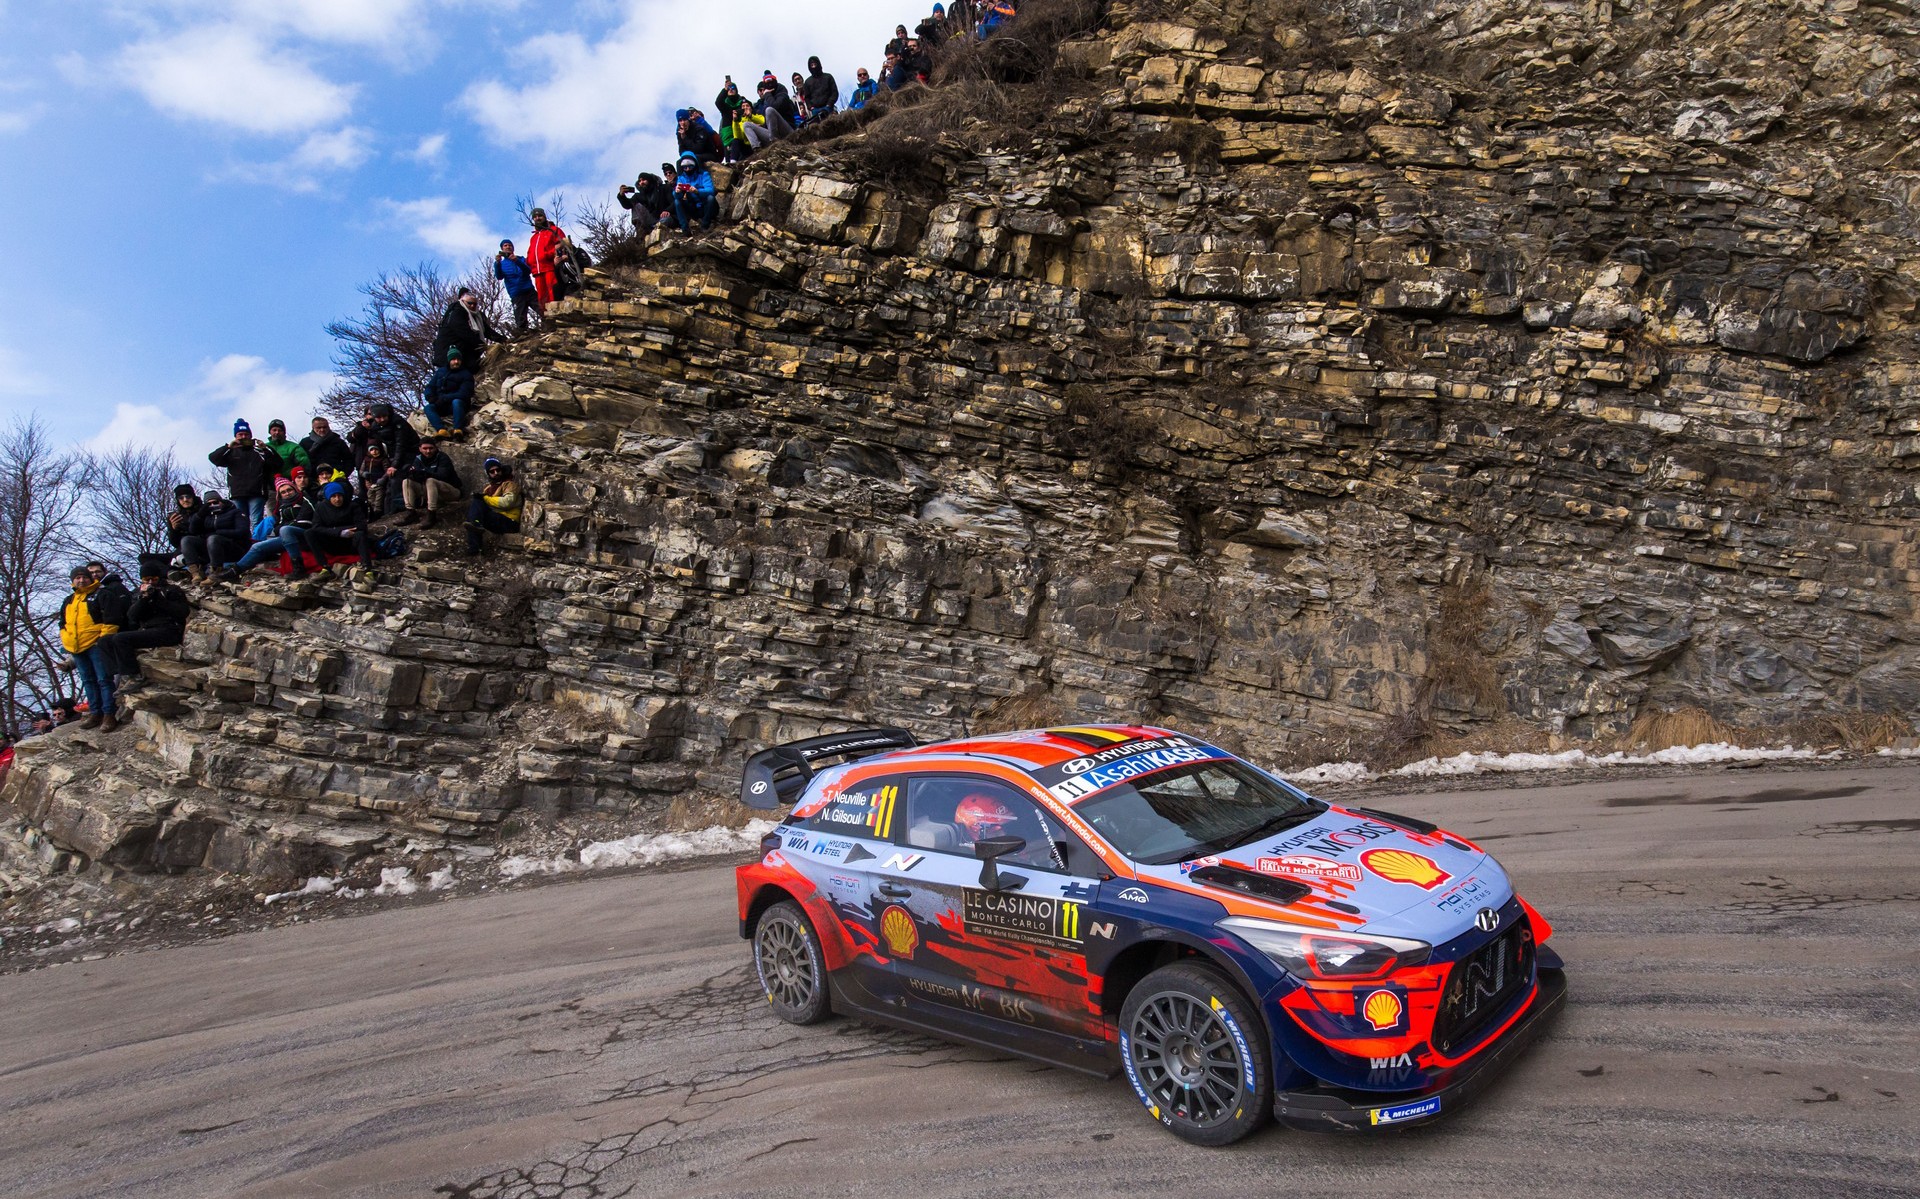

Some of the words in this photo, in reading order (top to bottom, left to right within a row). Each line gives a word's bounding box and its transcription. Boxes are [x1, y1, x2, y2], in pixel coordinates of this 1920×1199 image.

[820, 737, 894, 751] HYUNDAI
[1094, 740, 1164, 761] HYUNDAI
[1089, 747, 1213, 788] AsahiKASEI
[833, 789, 867, 806] Neuville
[1058, 781, 1089, 799] 11
[821, 808, 830, 820] N.
[832, 810, 862, 825] Gilsoul
[874, 785, 899, 838] 11
[1030, 786, 1107, 857] motorsport.hyundai.com
[788, 837, 809, 851] WIA
[828, 840, 853, 849] HYUNDAI
[1267, 827, 1333, 856] HYUNDAI
[1304, 822, 1397, 857] MOBIS
[824, 848, 841, 857] STEEL
[1260, 862, 1291, 872] RALLYE
[1293, 867, 1357, 879] MONTE-CARLO
[966, 891, 983, 909] LE
[985, 894, 1052, 919] CASINO
[1454, 889, 1491, 915] SYSTEMS
[1062, 901, 1079, 939] 11
[909, 978, 959, 999] HYUNDAI
[1226, 1019, 1254, 1086] MICHELIN
[1370, 1053, 1413, 1069] WIA
[1121, 1036, 1145, 1098] MICHELIN
[1392, 1102, 1435, 1118] MICHELIN
